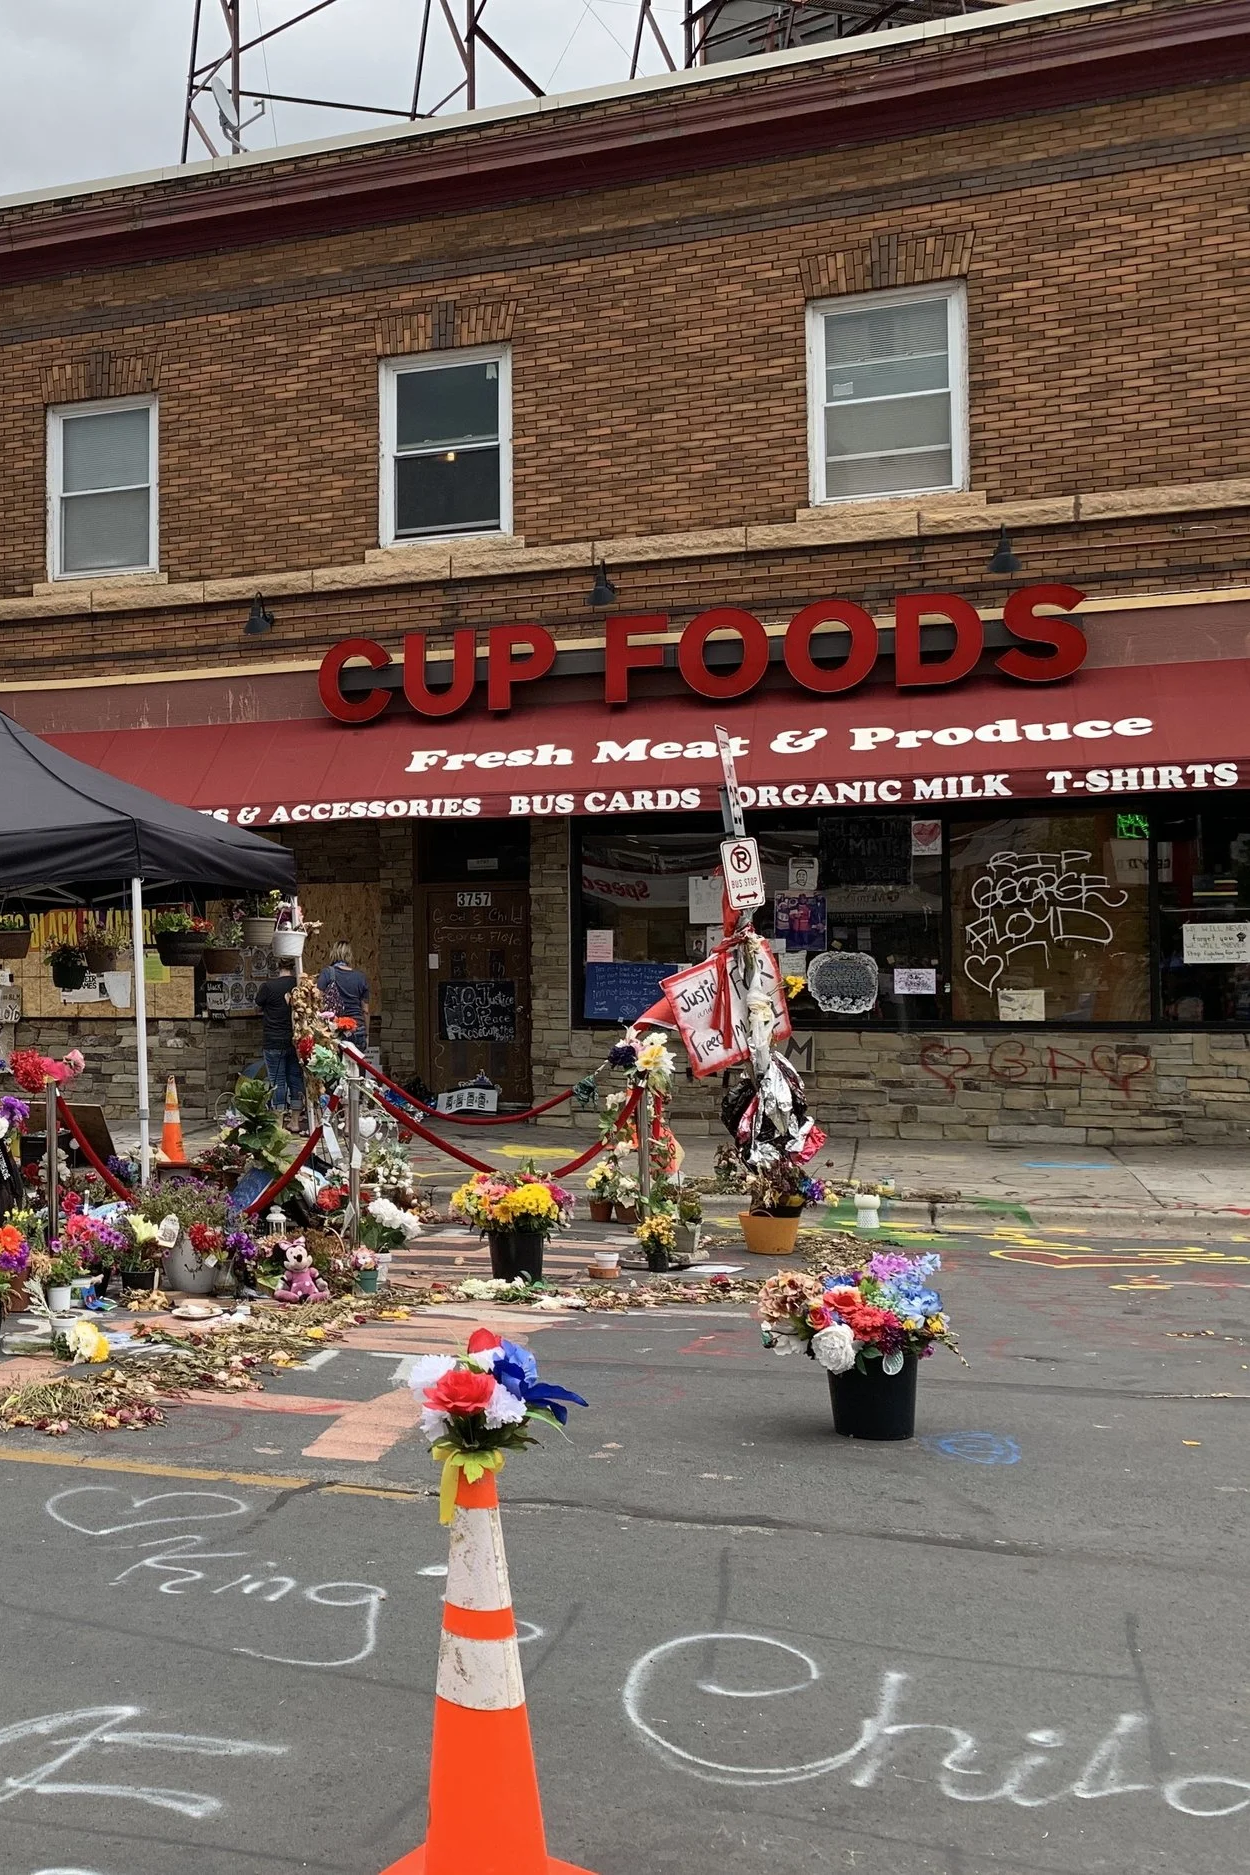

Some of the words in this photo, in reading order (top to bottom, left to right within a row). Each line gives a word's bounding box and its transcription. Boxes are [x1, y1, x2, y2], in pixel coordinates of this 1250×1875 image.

[318, 624, 557, 722] CUP
[604, 583, 1088, 705] FOODS
[404, 743, 573, 773] Fresh
[592, 736, 750, 764] Meat
[770, 727, 828, 754] &
[849, 716, 1154, 752] Produce
[236, 806, 261, 825] &
[268, 797, 482, 824] ACCESSORIES
[509, 792, 575, 816] BUS
[584, 788, 701, 813] CARDS
[737, 779, 902, 807] ORGANIC
[913, 773, 1013, 801] MILK
[1046, 763, 1239, 795] T-SHIRTS
[731, 878, 743, 888] BUS
[744, 877, 758, 887] STOP
[986, 850, 1092, 879] RIP
[458, 892, 491, 906] 3757
[972, 871, 1128, 910] GEORGE
[29, 911, 78, 949] BLACK
[965, 906, 1114, 951] FLOYD
[674, 979, 718, 1014] Justic
[106, 1534, 388, 1667] King
